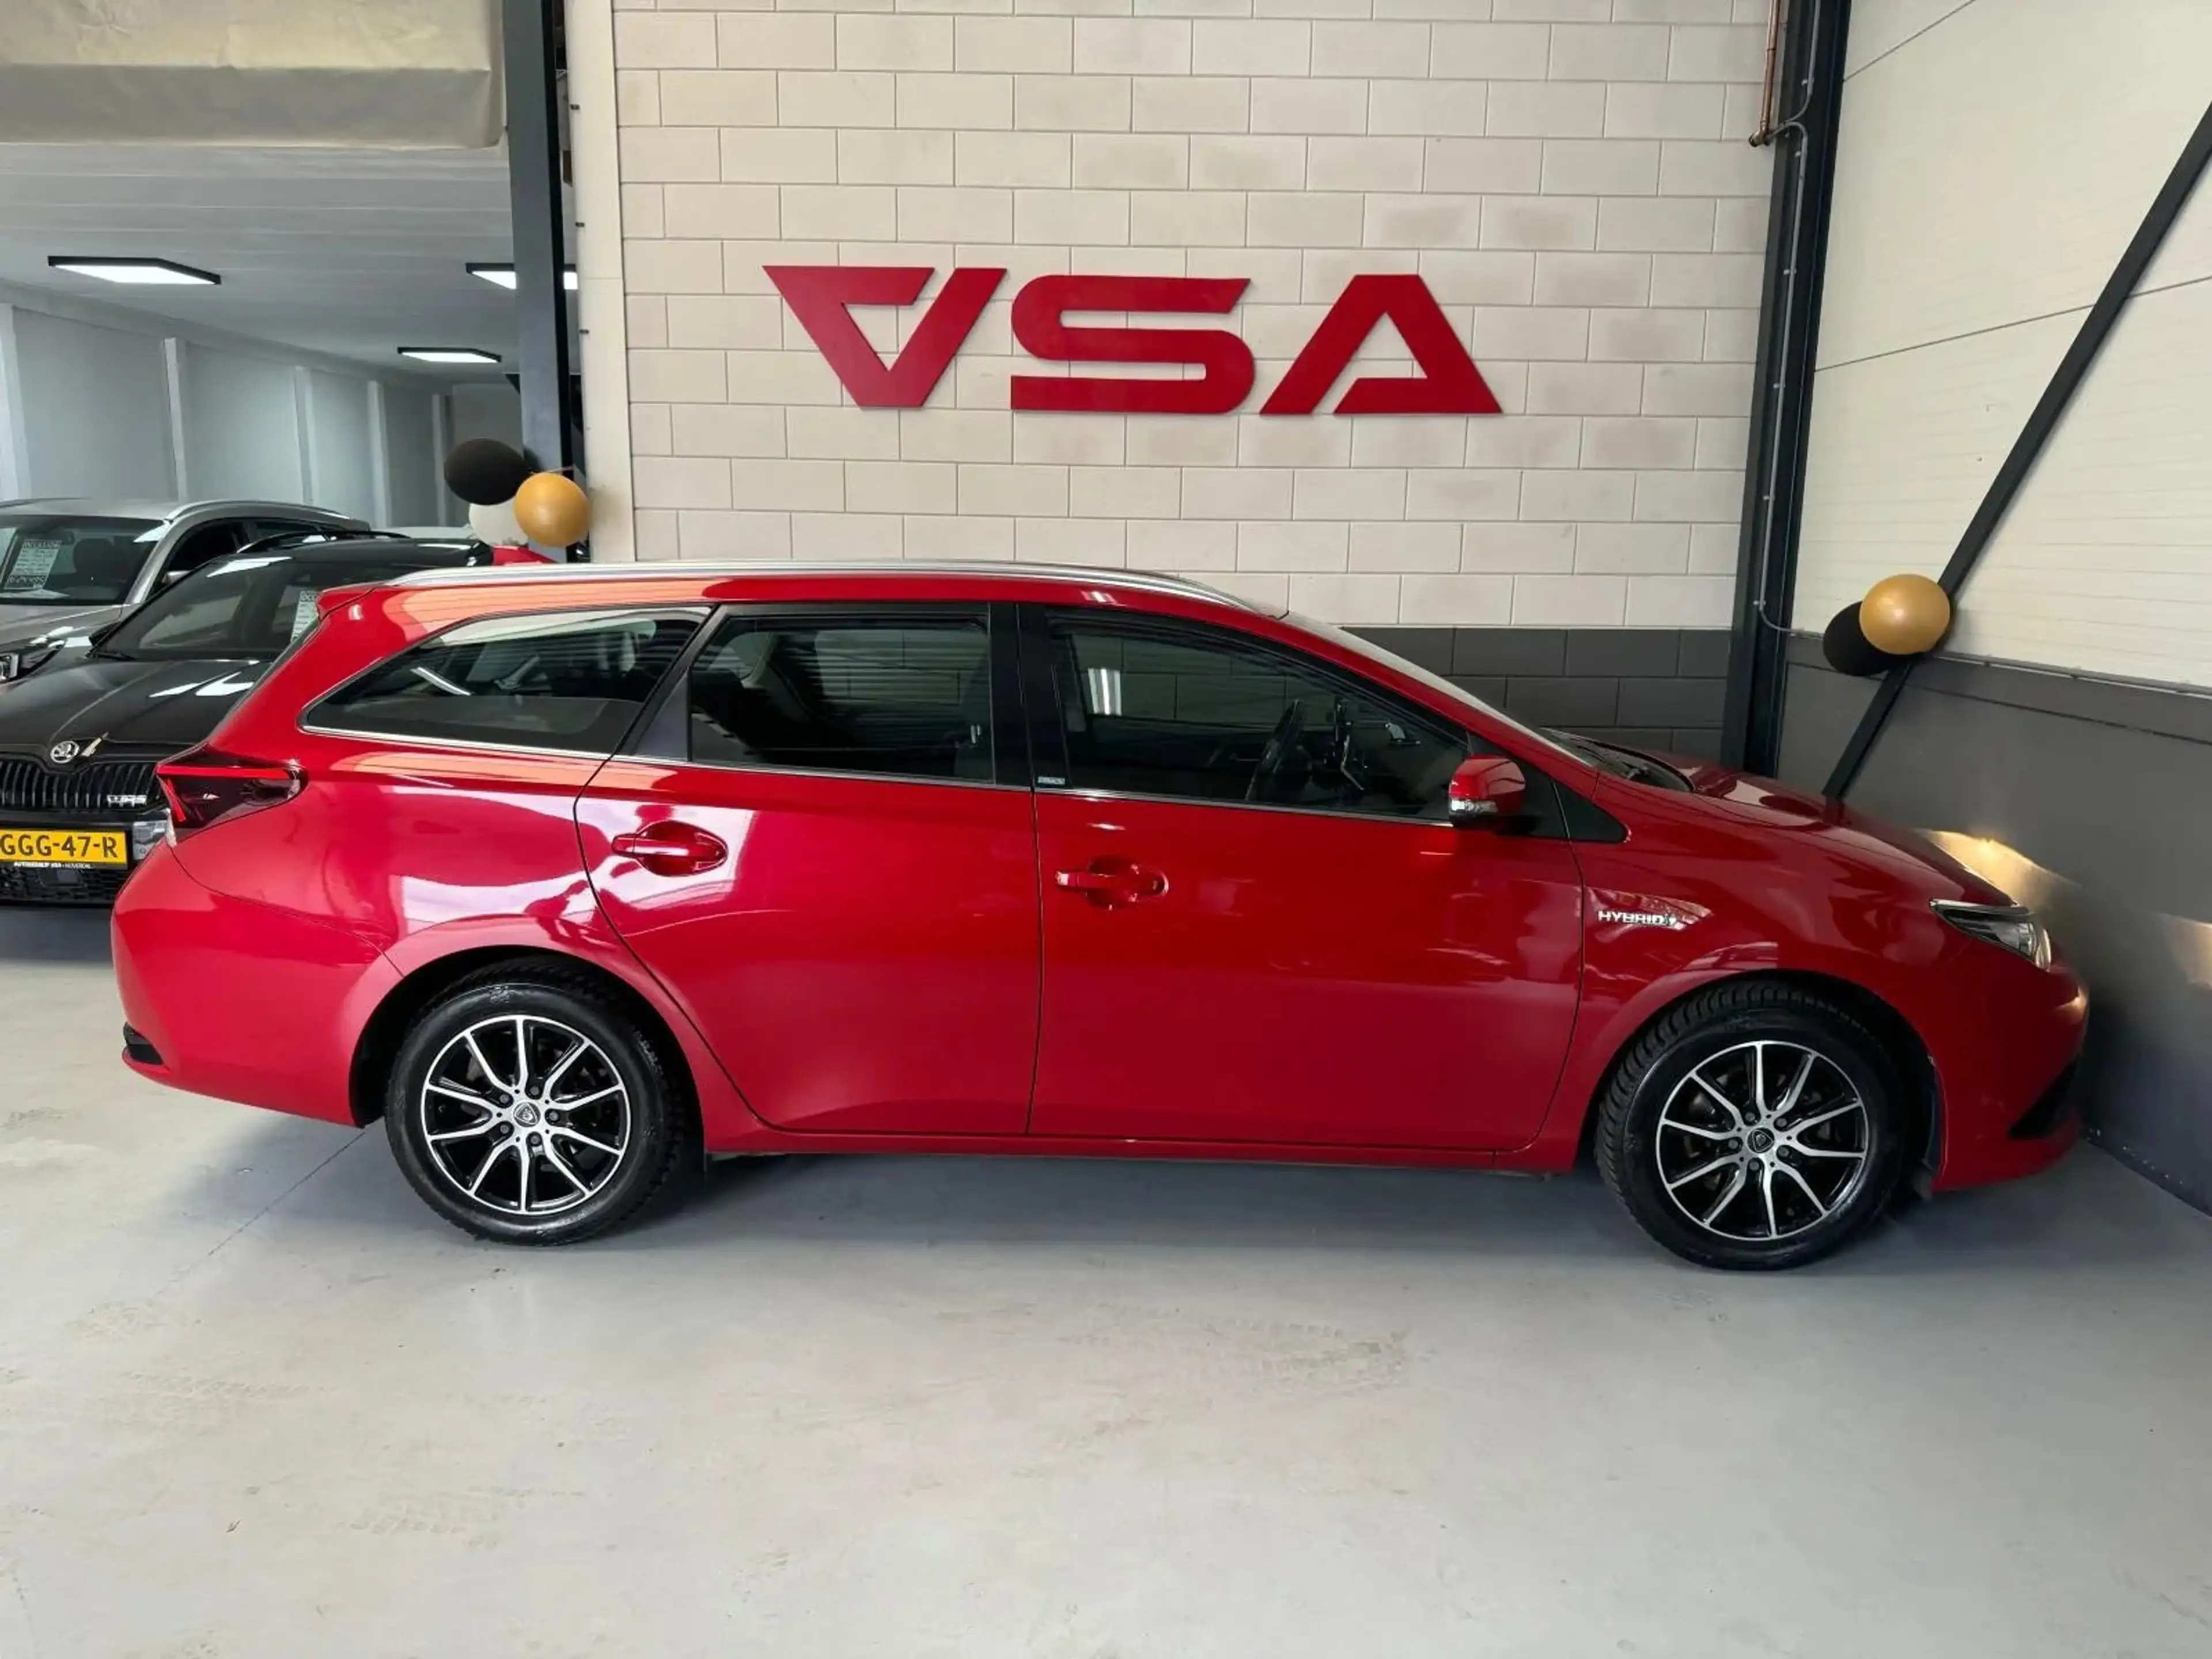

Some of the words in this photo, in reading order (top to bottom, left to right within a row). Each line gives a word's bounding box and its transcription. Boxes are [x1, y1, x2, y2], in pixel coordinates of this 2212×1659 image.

[762, 266, 1503, 415] VSA
[0, 834, 118, 858] GGG-47-R
[1598, 911, 1664, 925] HYBRID
